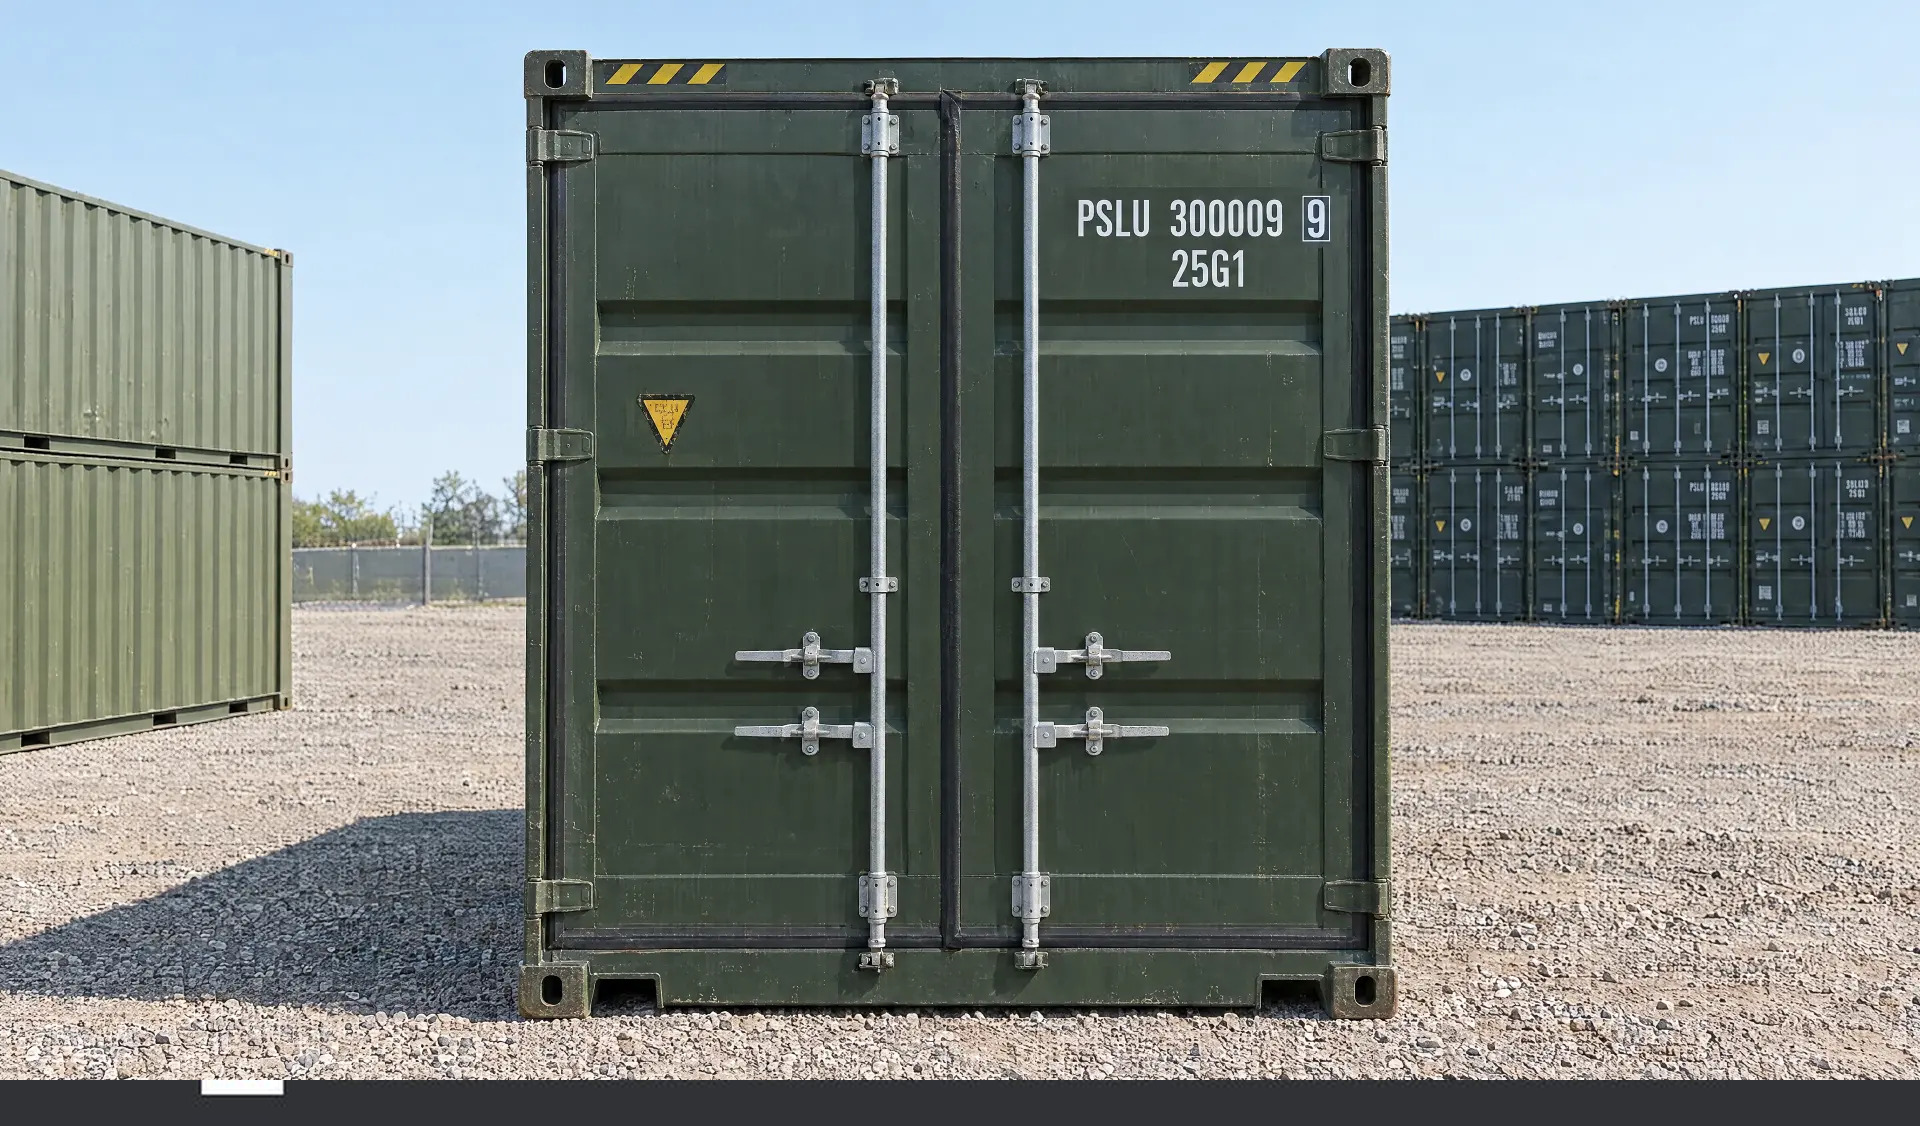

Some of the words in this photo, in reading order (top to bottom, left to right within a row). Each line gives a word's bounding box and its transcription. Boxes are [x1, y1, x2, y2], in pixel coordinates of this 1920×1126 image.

[1077, 199, 1150, 238] PSLU
[1170, 199, 1283, 238] 300009
[1306, 198, 1327, 240] 9
[1171, 249, 1244, 288] 25G1
